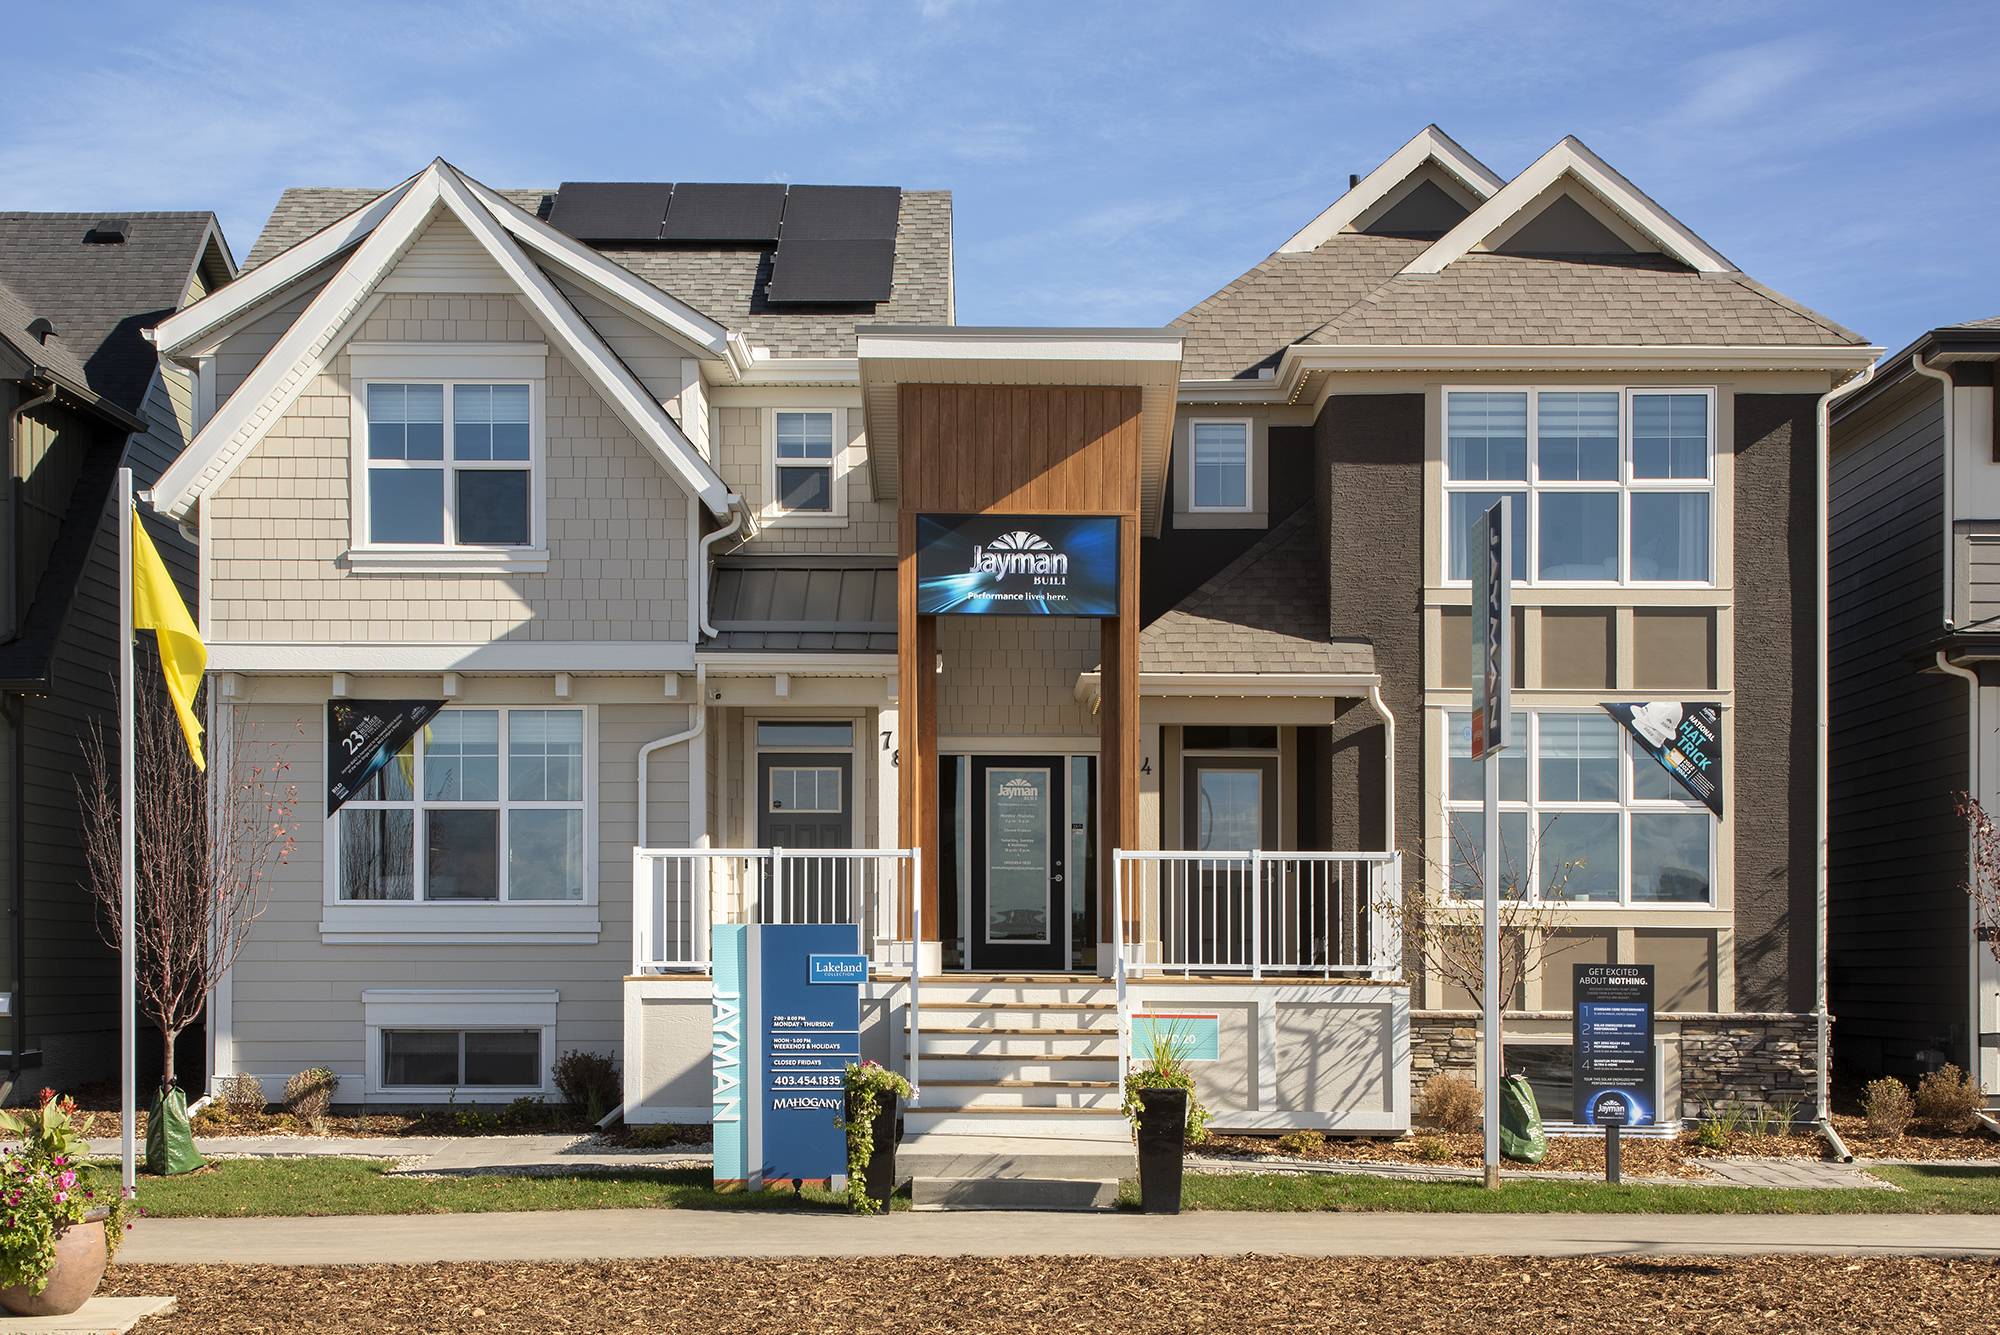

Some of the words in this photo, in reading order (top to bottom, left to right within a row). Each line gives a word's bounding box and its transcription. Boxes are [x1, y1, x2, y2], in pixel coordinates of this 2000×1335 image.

[969, 545, 1068, 582] Jayman
[968, 592, 1023, 601] Performance
[1025, 592, 1045, 601] lives
[1046, 592, 1069, 601] here.
[1490, 527, 1498, 730] JAYMAN
[1679, 721, 1707, 746] HAT
[1689, 714, 1715, 742] NATIONAL
[342, 730, 365, 755] 23
[1677, 735, 1712, 771] TRICK
[998, 784, 1038, 799] Jayman
[816, 961, 862, 972] Lakeland
[1588, 968, 1604, 976] GET
[1606, 968, 1639, 976] EXCITED
[1608, 977, 1648, 985] NOTHING.
[1584, 1005, 1588, 1017] 1
[1582, 1023, 1590, 1035] 2
[711, 983, 741, 1121] JAYMAN
[1582, 1041, 1590, 1053] 3
[1581, 1059, 1590, 1071] 4
[774, 1076, 840, 1085] 403.454.1835
[773, 1097, 842, 1110] MAHOGANY
[1598, 1104, 1625, 1114] Jayman
